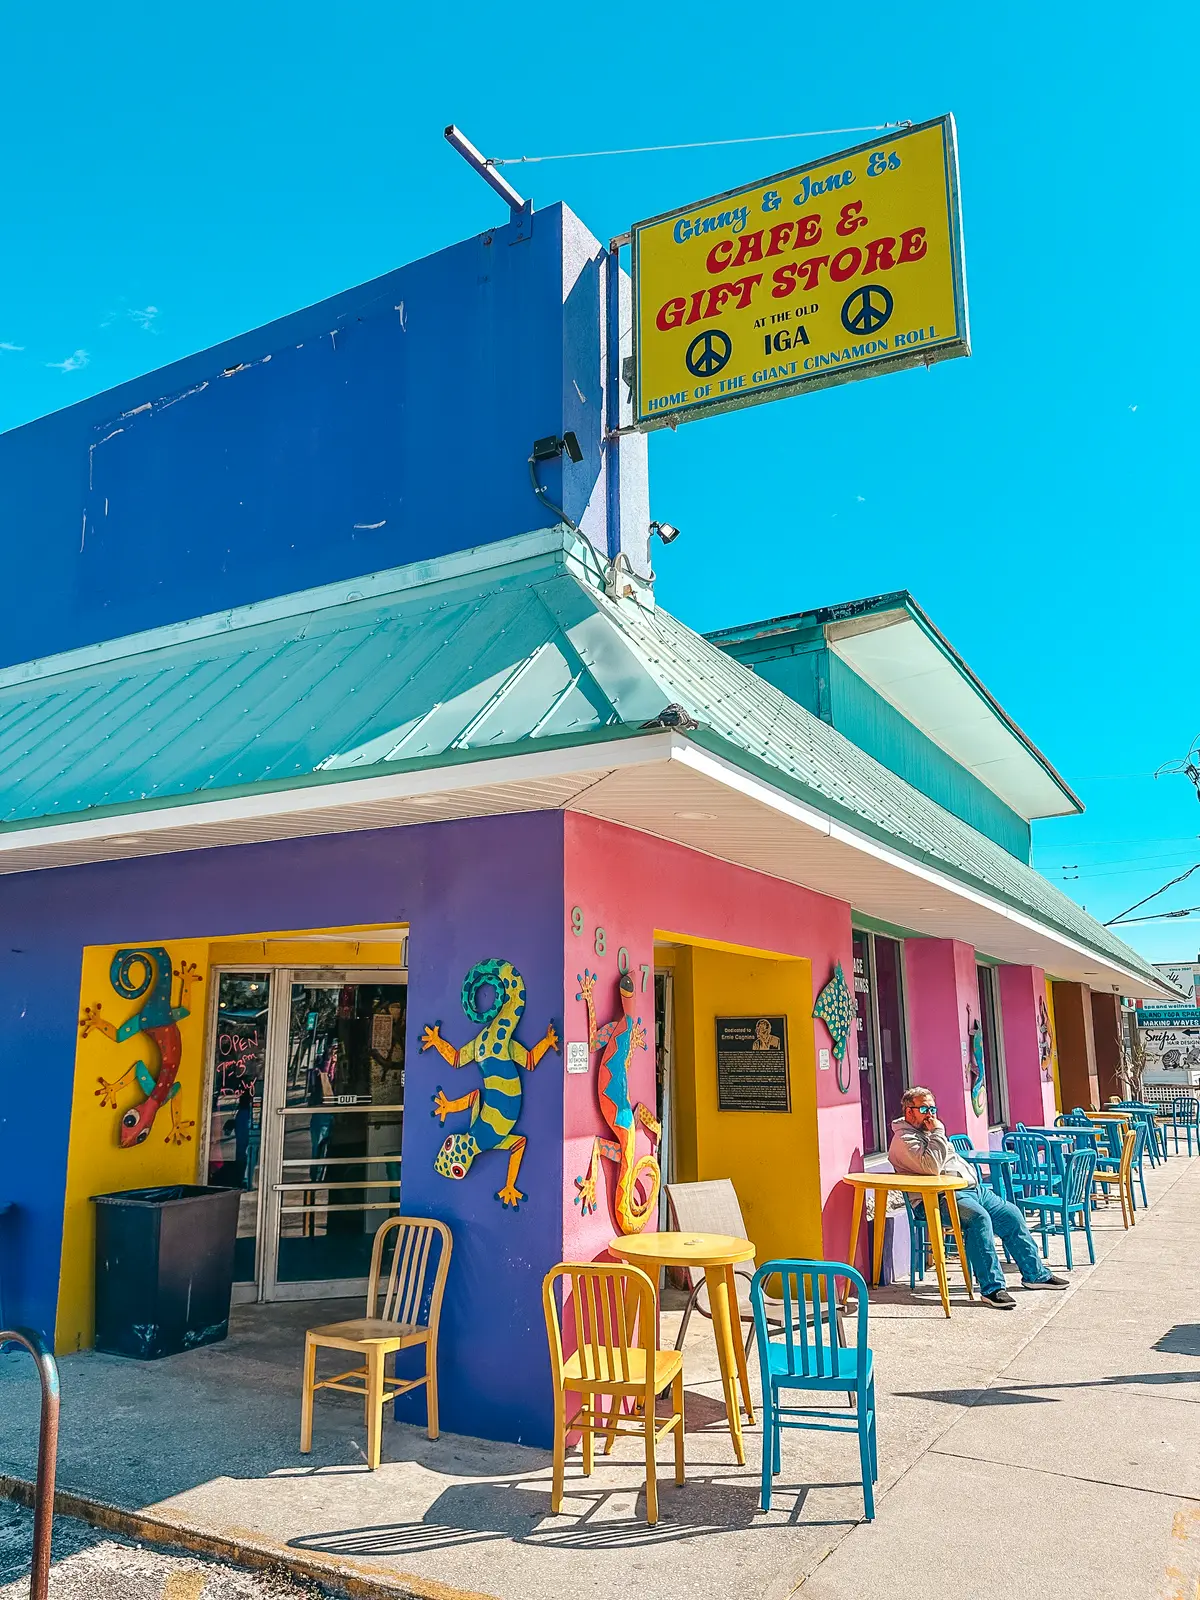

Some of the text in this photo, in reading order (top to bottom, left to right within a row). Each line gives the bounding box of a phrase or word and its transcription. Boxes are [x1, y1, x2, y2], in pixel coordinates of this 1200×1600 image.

[673, 206, 751, 244] Ginny
[761, 190, 782, 212] &
[793, 170, 856, 206] Jane
[706, 200, 869, 275] CAFE &
[656, 227, 928, 332] GIFT STORE
[753, 303, 819, 329] AT THE OLD
[764, 325, 811, 355] IGA
[648, 325, 940, 411] HOME OF THE GIANT CINNAMON ROLL
[219, 1030, 258, 1055] OPEN
[1145, 1029, 1177, 1050] Snips
[220, 1077, 257, 1098] Daily
[340, 1095, 356, 1104] OUT
